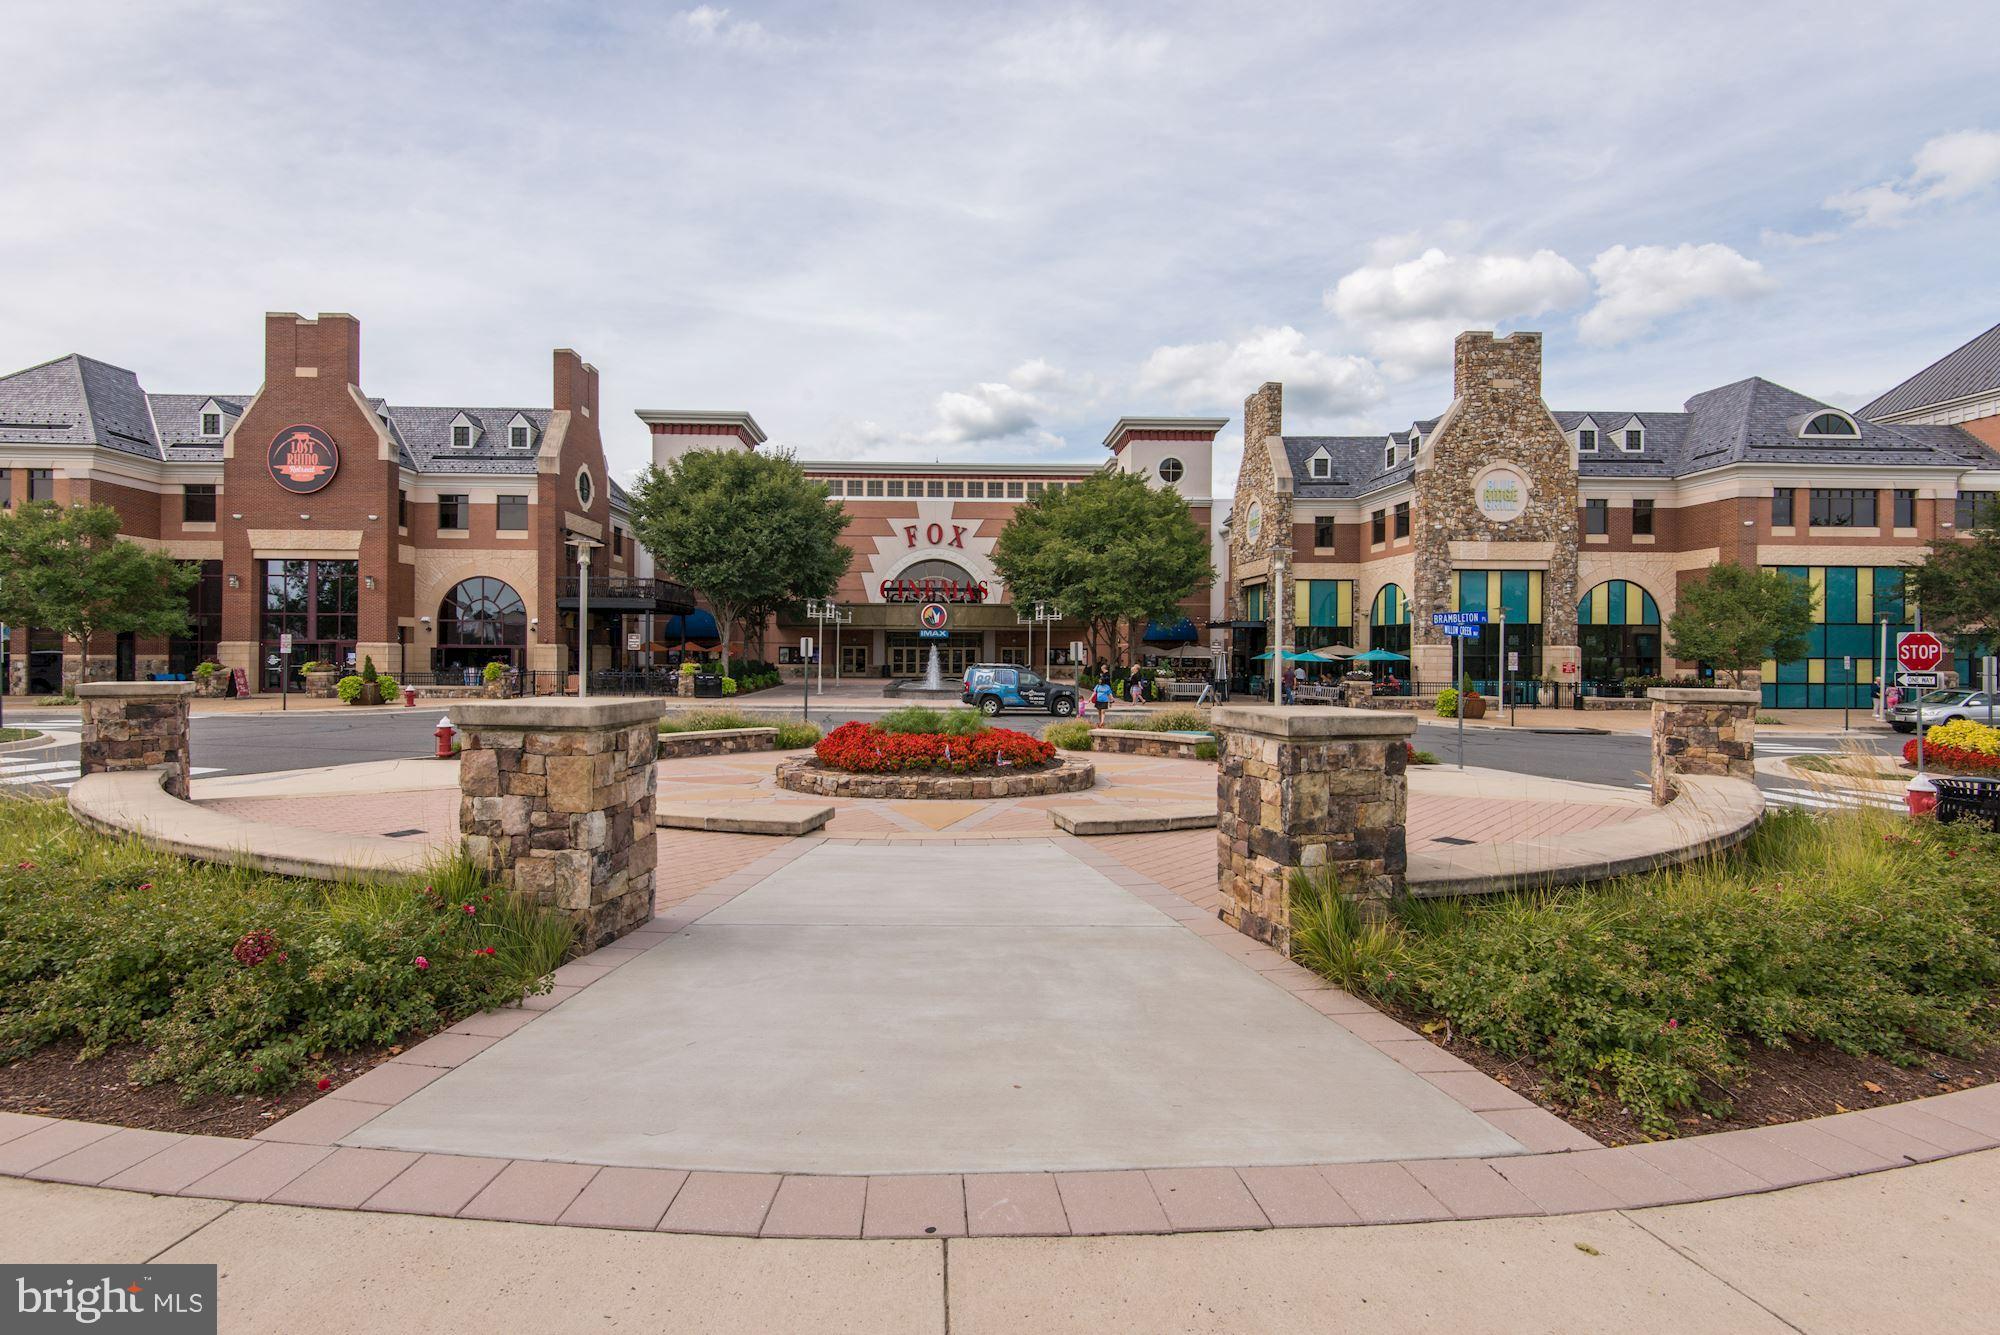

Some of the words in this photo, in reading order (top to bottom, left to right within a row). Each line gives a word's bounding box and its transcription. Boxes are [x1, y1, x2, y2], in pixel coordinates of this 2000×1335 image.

[291, 441, 315, 454] LOST
[287, 453, 319, 465] RHINO
[904, 523, 968, 549] FOX
[879, 579, 989, 602] CINEMAS
[1433, 613, 1479, 624] BRAMBLETON
[1459, 626, 1472, 636] CREEK
[1900, 644, 1939, 660] STOP
